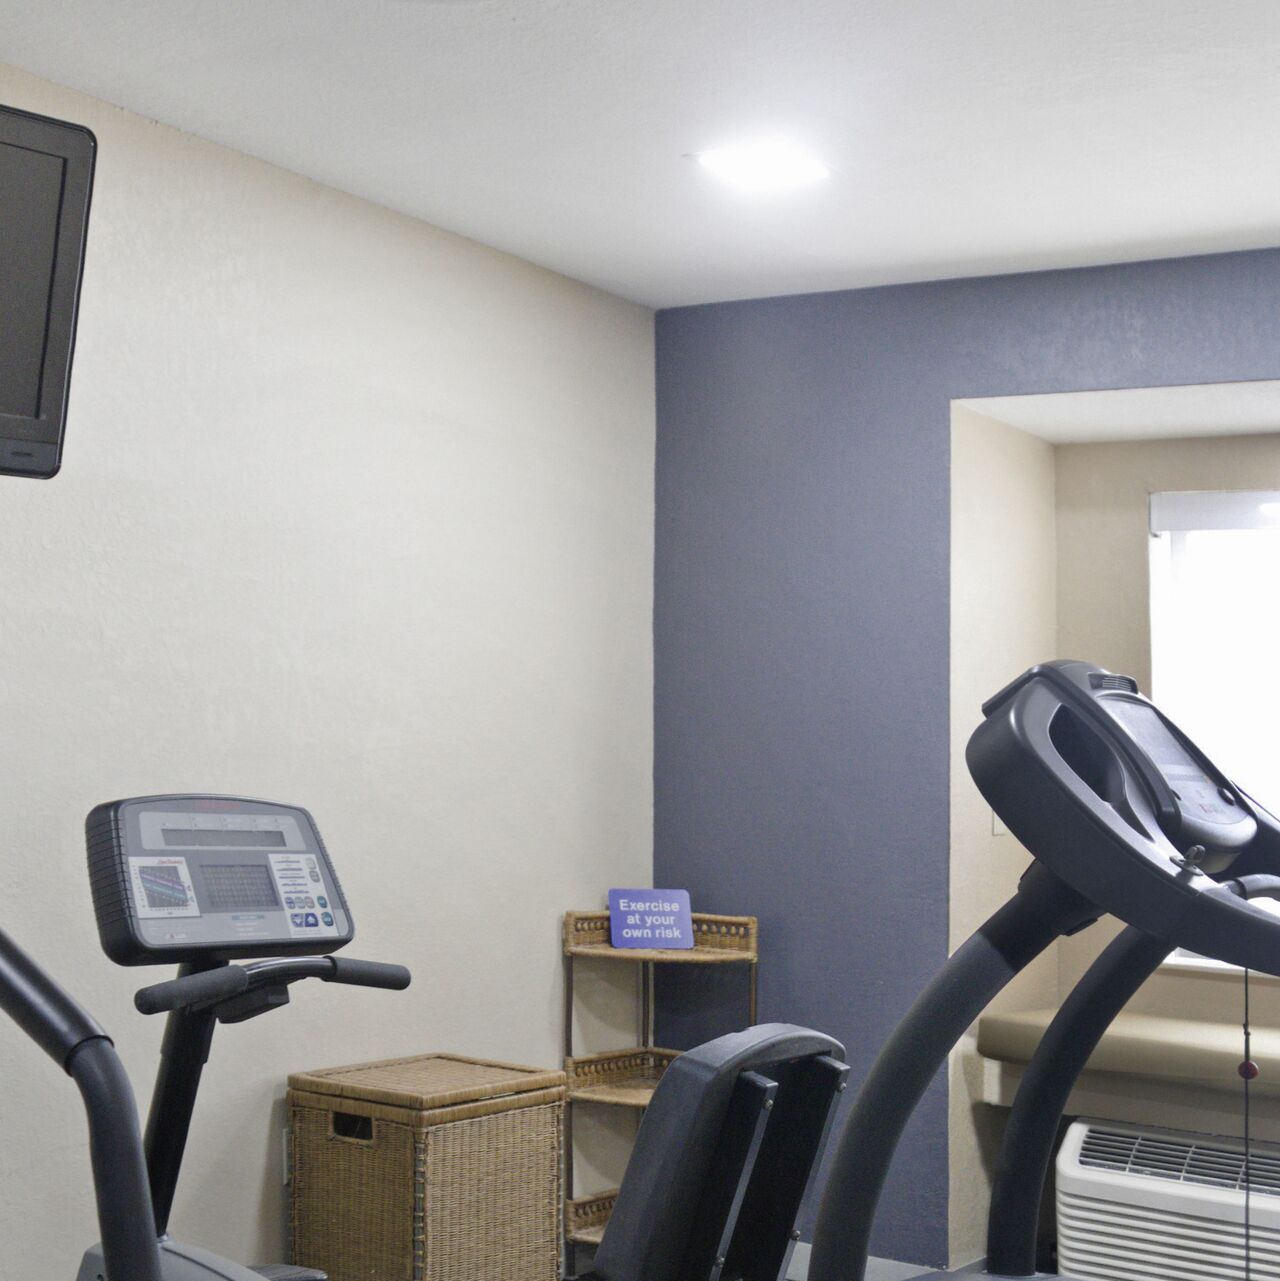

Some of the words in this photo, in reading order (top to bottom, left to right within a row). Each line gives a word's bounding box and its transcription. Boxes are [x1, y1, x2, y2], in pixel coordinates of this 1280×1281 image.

[619, 899, 680, 912] Exercise
[626, 914, 641, 925] at
[645, 914, 676, 926] your
[622, 927, 652, 938] own
[655, 926, 682, 938] risk
